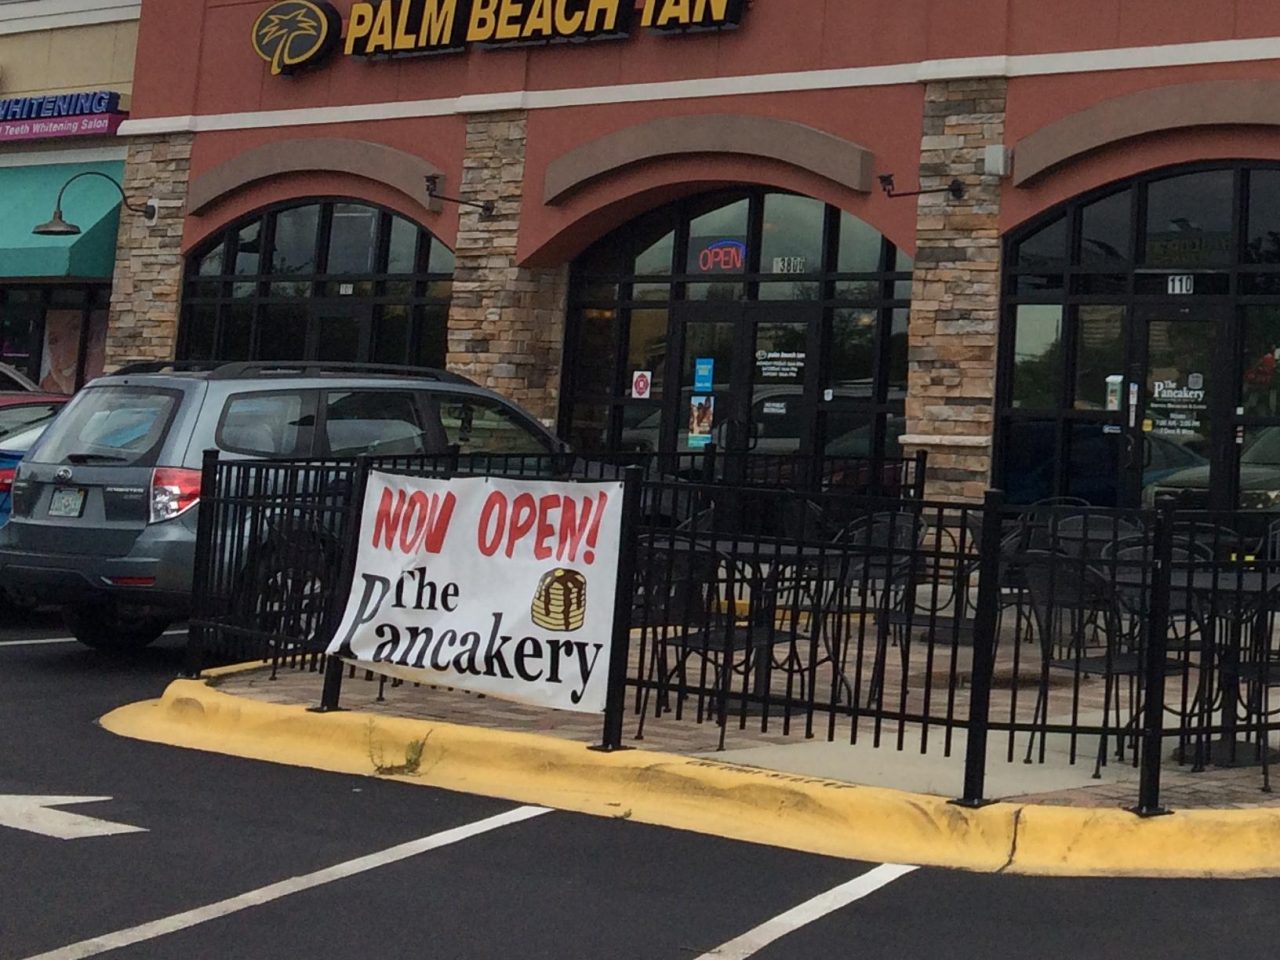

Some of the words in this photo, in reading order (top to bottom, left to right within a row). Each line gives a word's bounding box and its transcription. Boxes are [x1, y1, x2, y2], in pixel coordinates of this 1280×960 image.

[5, 124, 29, 135] Teeth
[33, 121, 78, 133] Whitening
[81, 118, 108, 129] Salon
[700, 247, 742, 271] OPEN
[1170, 275, 1193, 293] 110
[1153, 381, 1205, 401] Pancakery
[372, 486, 456, 554] NOW
[477, 490, 607, 565] OPEN!
[391, 567, 459, 612] The
[334, 573, 603, 704] Pancakery
